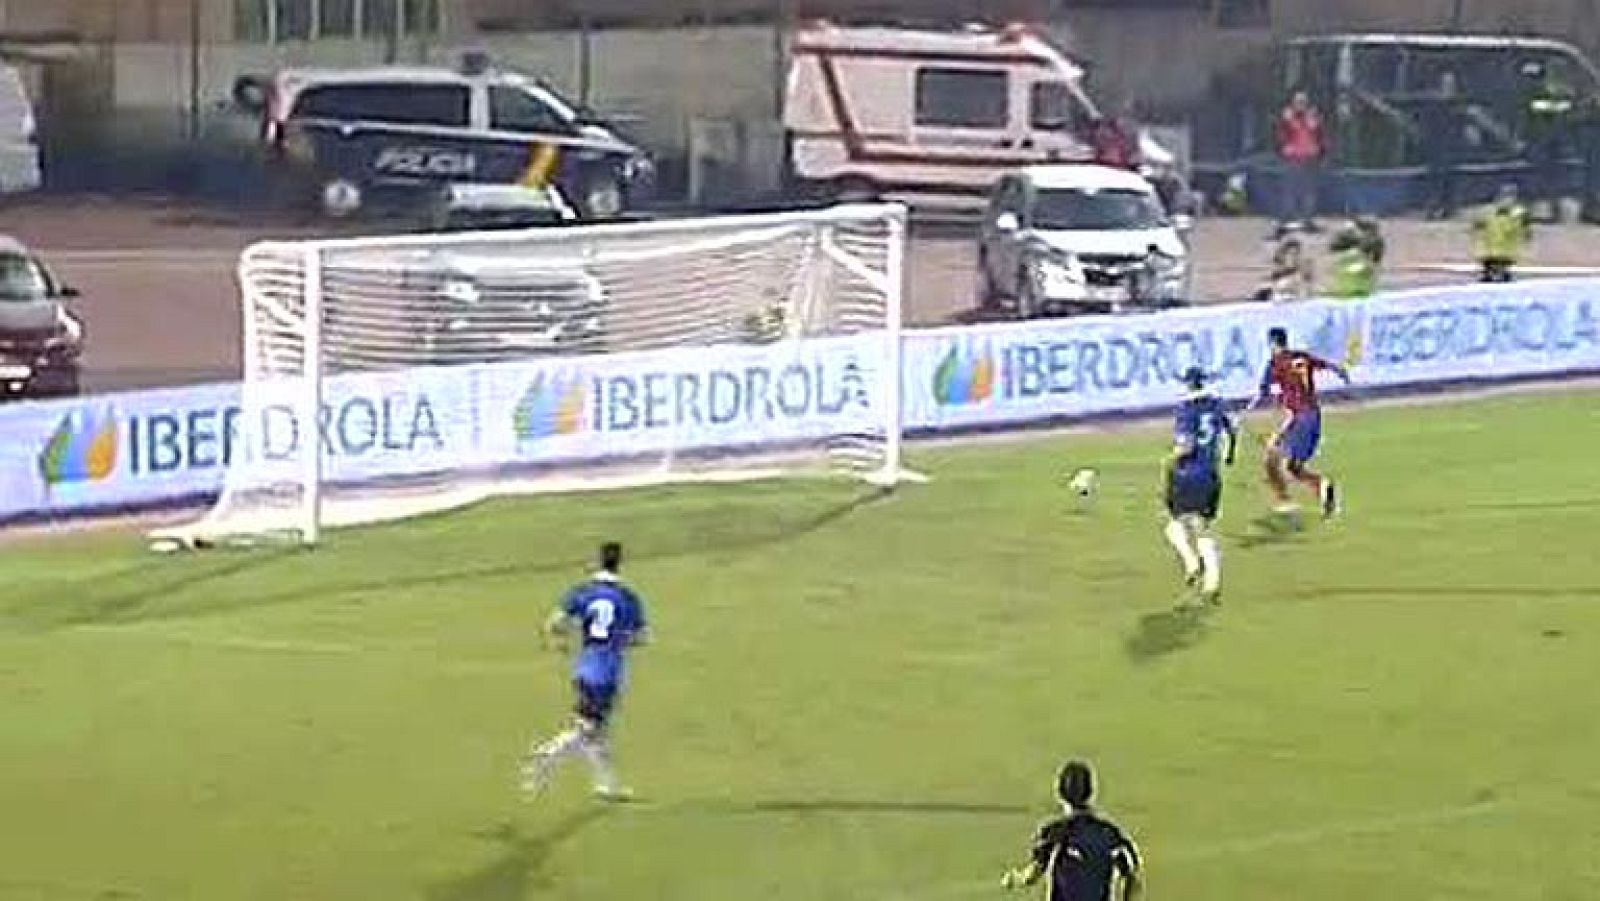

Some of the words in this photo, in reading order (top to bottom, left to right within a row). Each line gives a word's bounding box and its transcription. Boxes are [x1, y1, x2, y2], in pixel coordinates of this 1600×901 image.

[593, 355, 870, 431] IBERDROLA
[1002, 327, 1250, 399] IBERDROLA
[587, 598, 615, 639] 2
